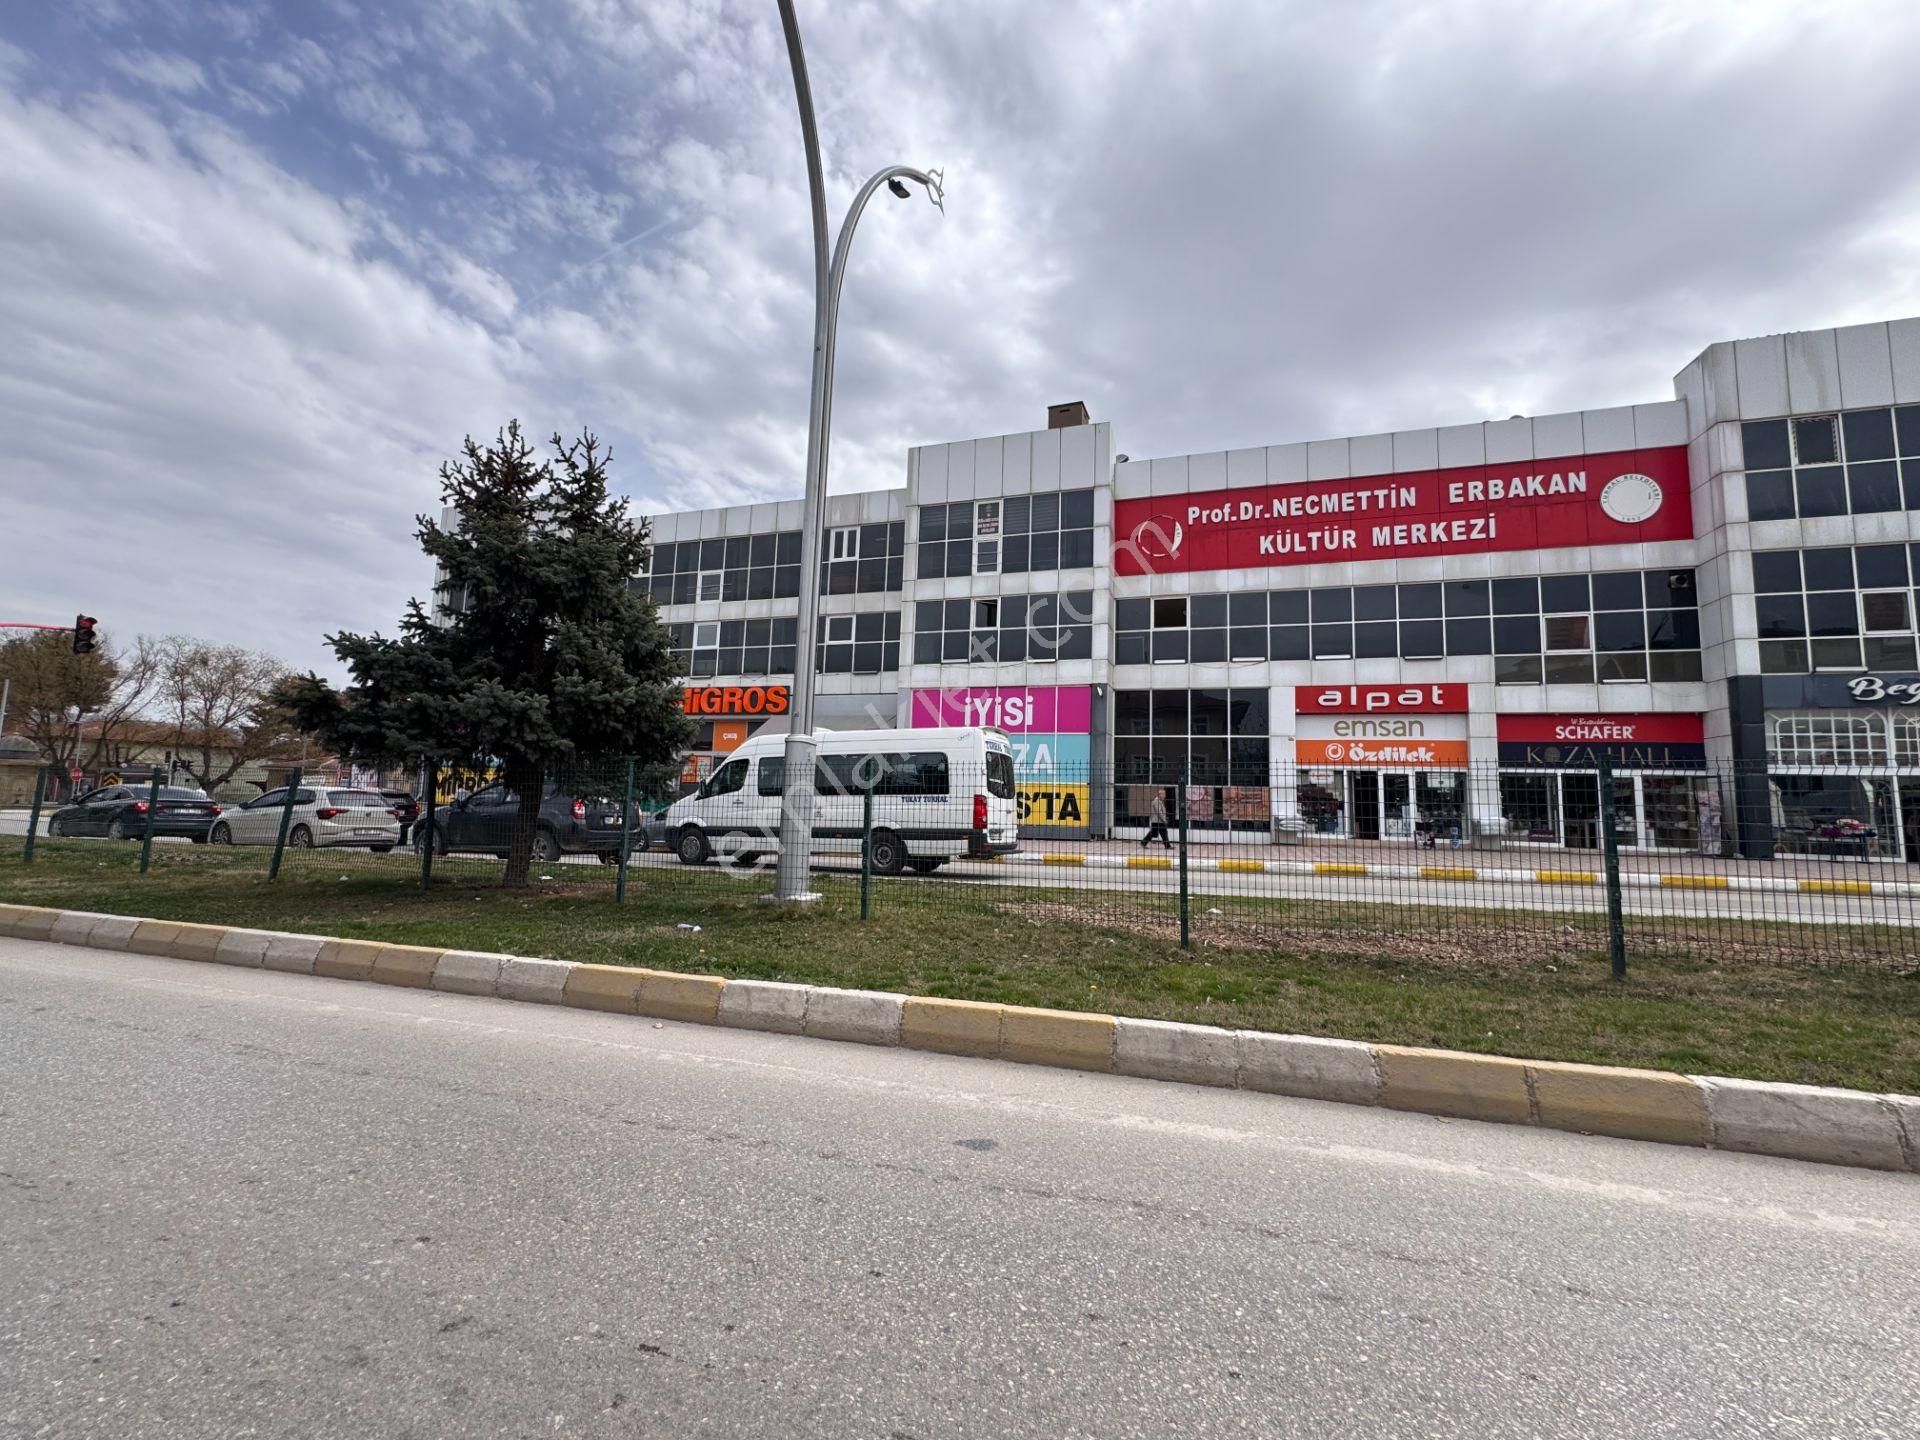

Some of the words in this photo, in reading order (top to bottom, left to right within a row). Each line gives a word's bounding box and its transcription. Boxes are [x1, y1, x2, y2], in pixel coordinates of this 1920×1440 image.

[1448, 471, 1588, 504] ERBAKAN
[1259, 526, 1357, 555] KÜLTÜR
[1371, 513, 1497, 547] MERKEZİ
[1318, 686, 1444, 711] alpat
[1333, 719, 1425, 737] emsan
[1555, 725, 1634, 740] SCHAFER
[1349, 742, 1436, 763] Özdilek
[1526, 746, 1598, 764] KOZA
